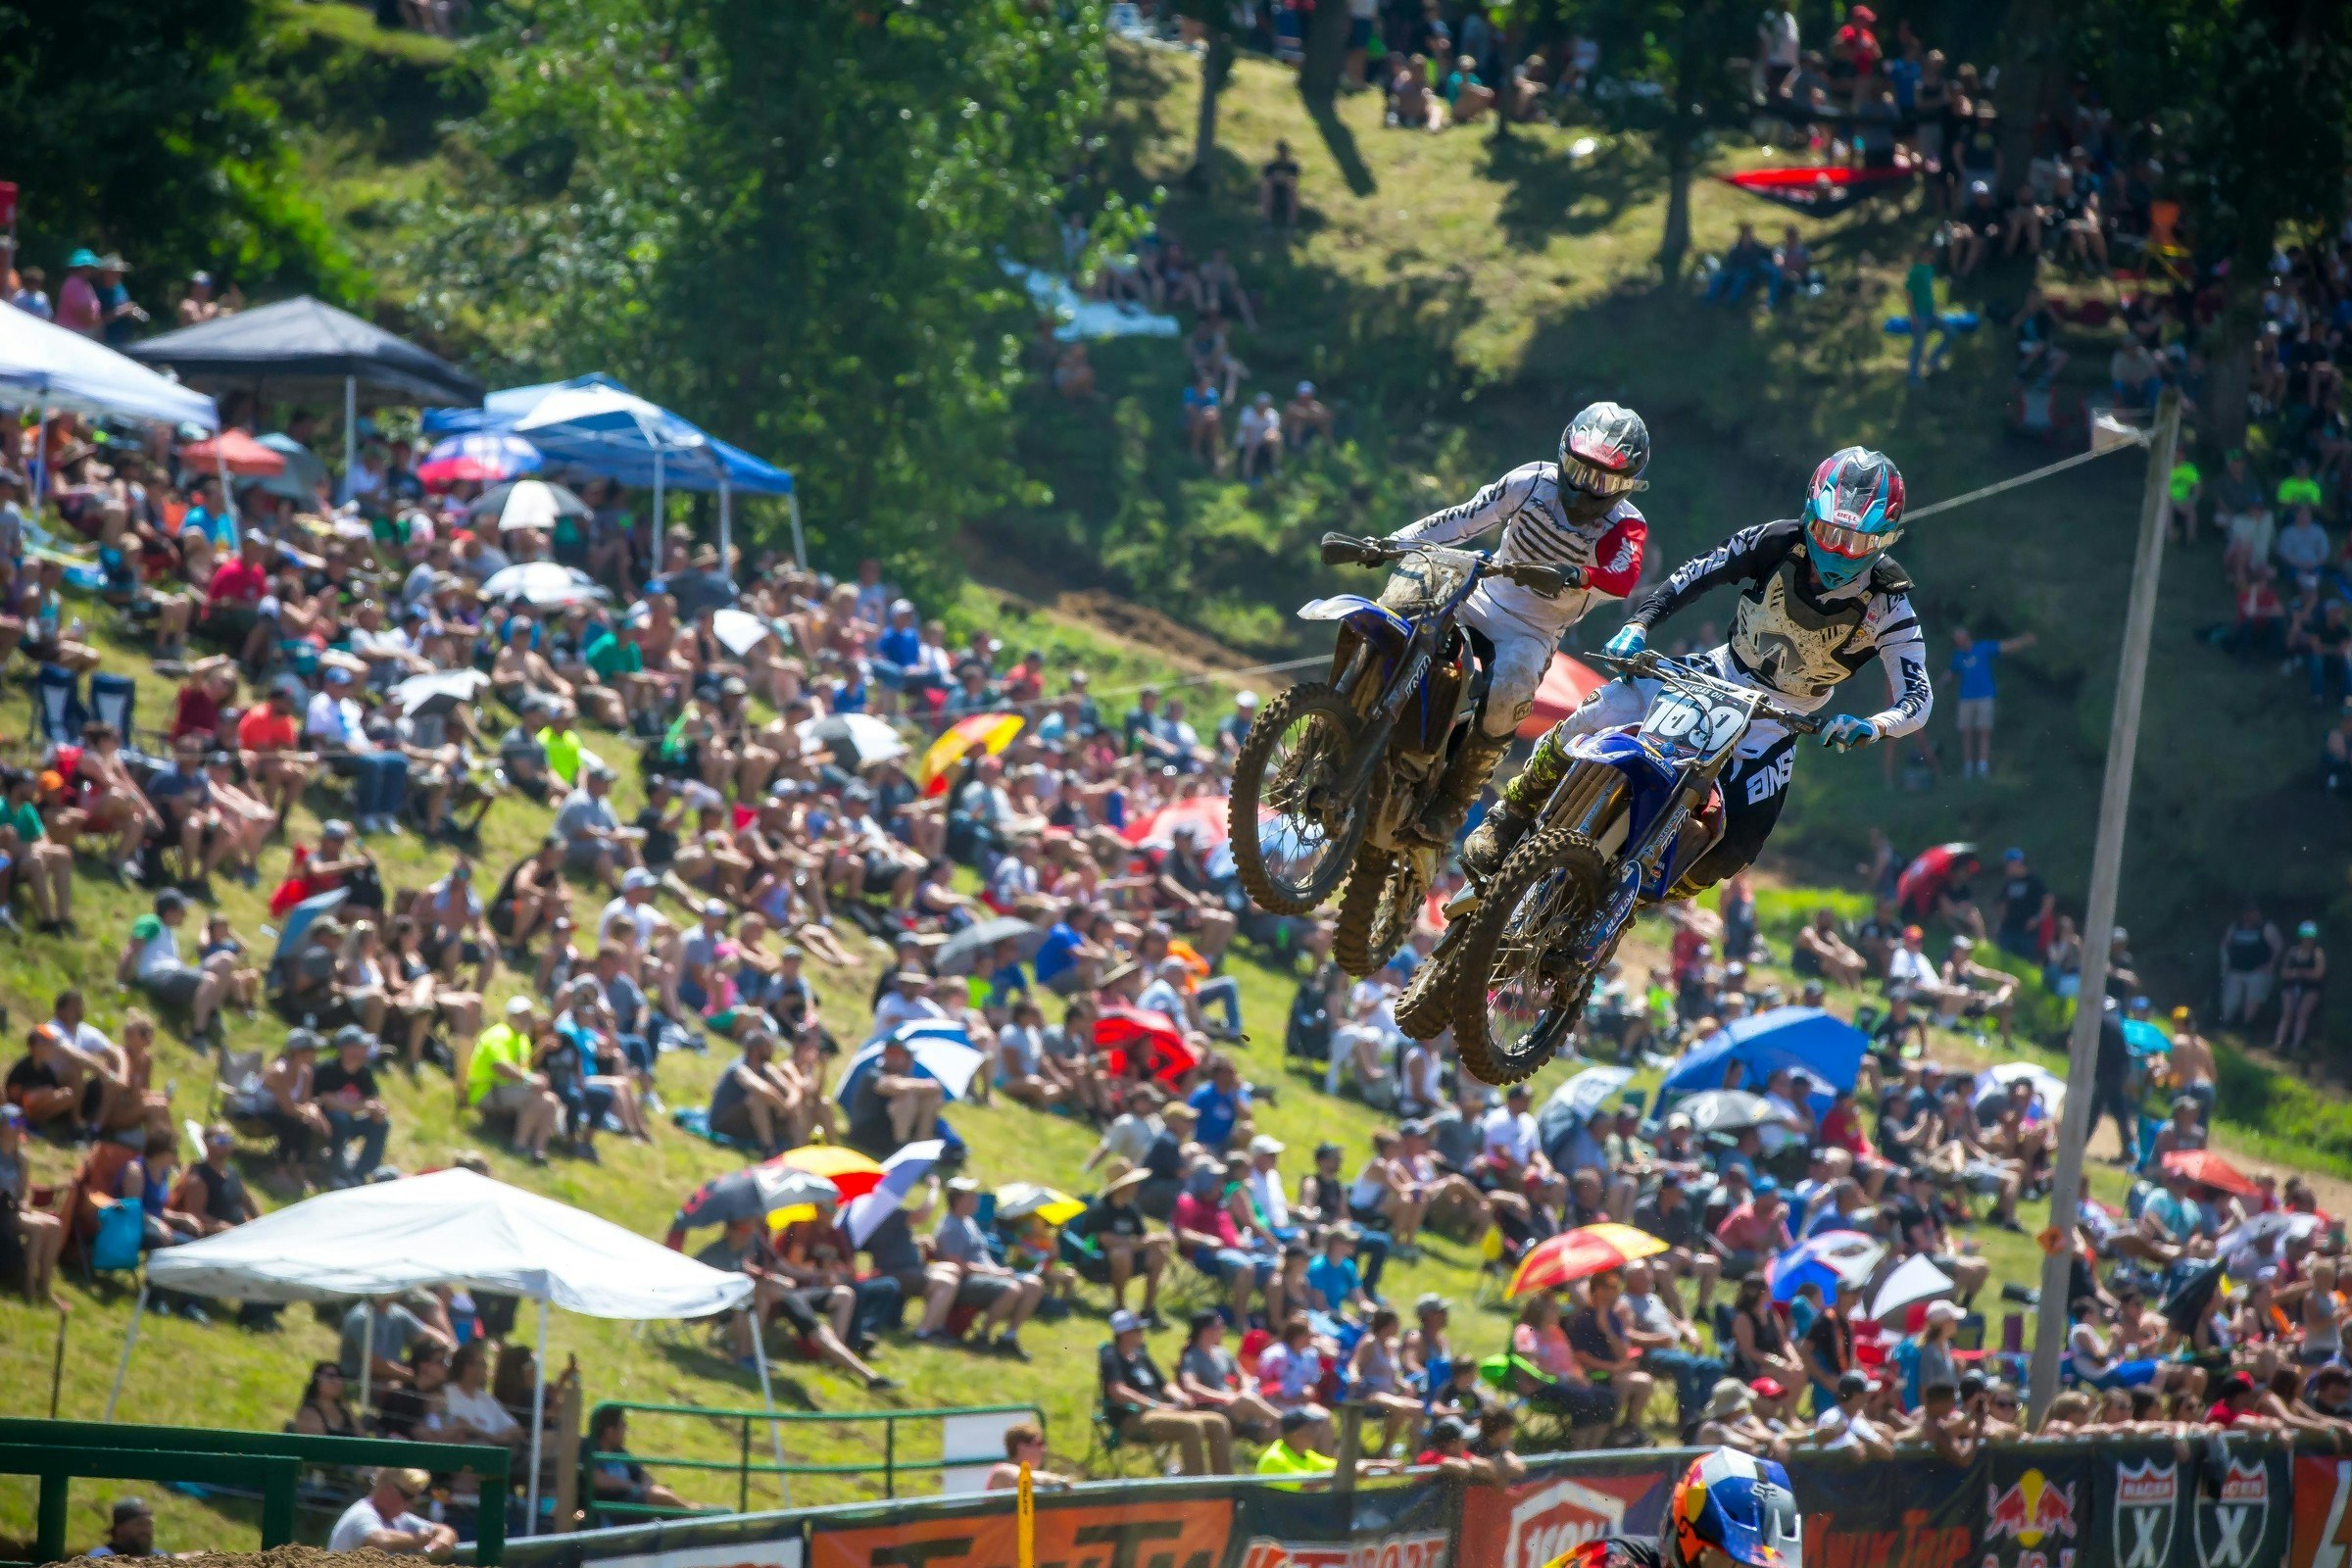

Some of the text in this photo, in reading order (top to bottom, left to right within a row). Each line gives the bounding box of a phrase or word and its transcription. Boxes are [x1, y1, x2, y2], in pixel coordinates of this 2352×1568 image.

[1836, 512, 1858, 521] BELL
[1686, 685, 1726, 702] LUCAS OIL
[1604, 889, 1637, 936] DUNLOP
[2126, 1507, 2163, 1568] X
[2209, 1504, 2249, 1567] X
